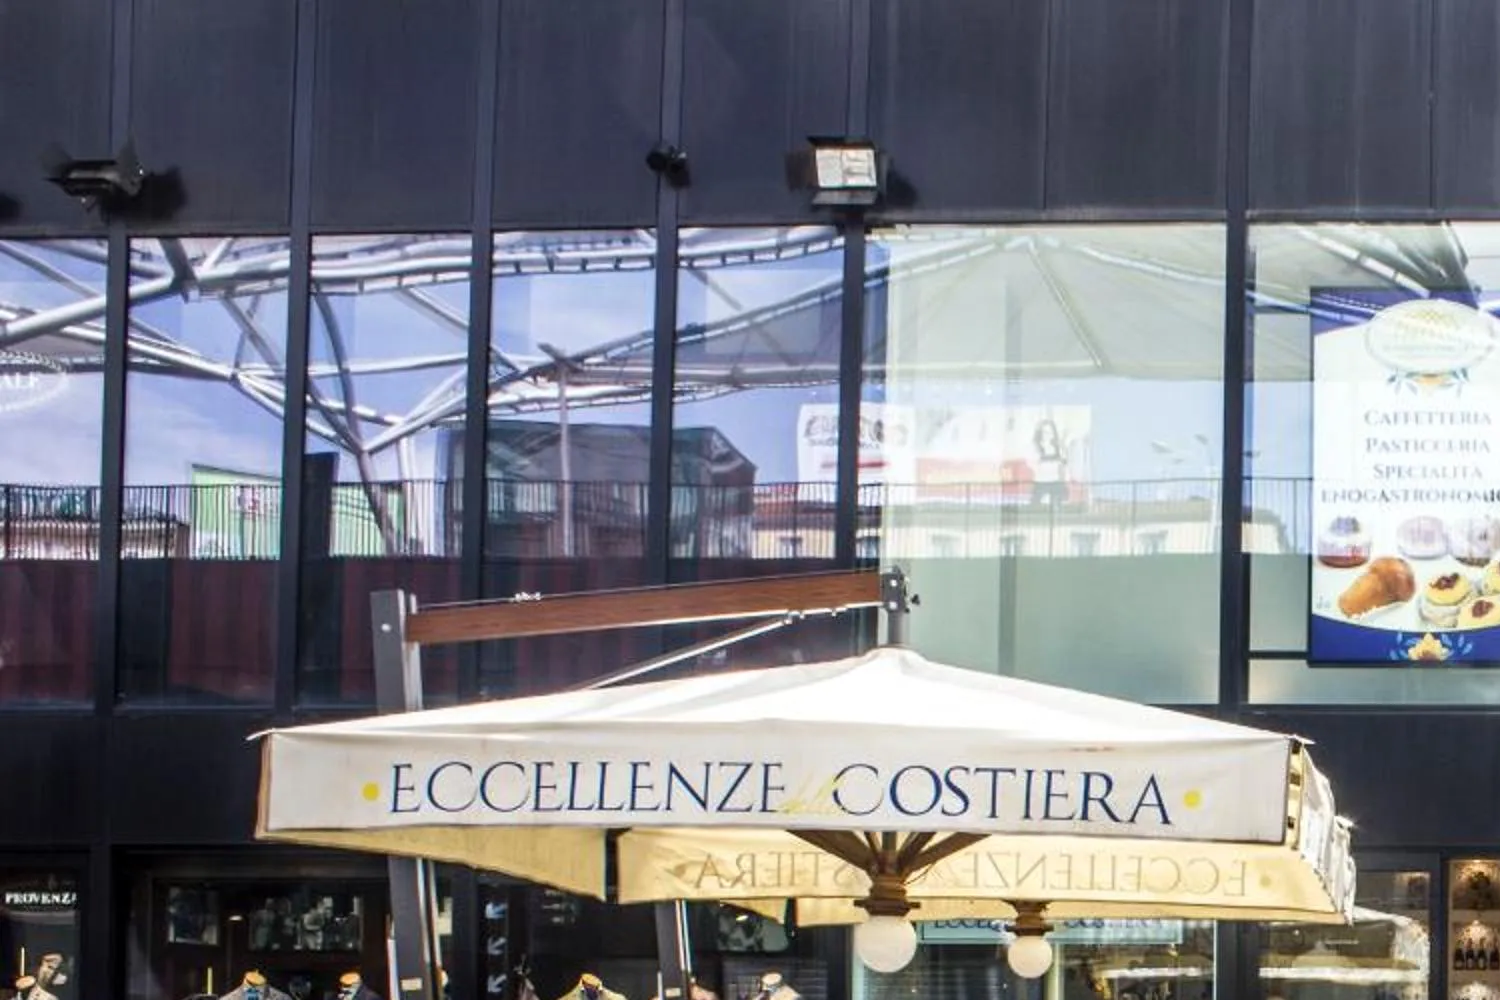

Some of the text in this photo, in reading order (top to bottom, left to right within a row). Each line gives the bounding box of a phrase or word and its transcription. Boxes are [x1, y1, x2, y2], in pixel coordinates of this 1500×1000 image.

[1364, 410, 1492, 426] CAFFETTERIA
[1366, 438, 1491, 454] PASTICCERIA
[390, 761, 785, 813] ECCELLENZE
[832, 763, 1173, 826] COSTIERA
